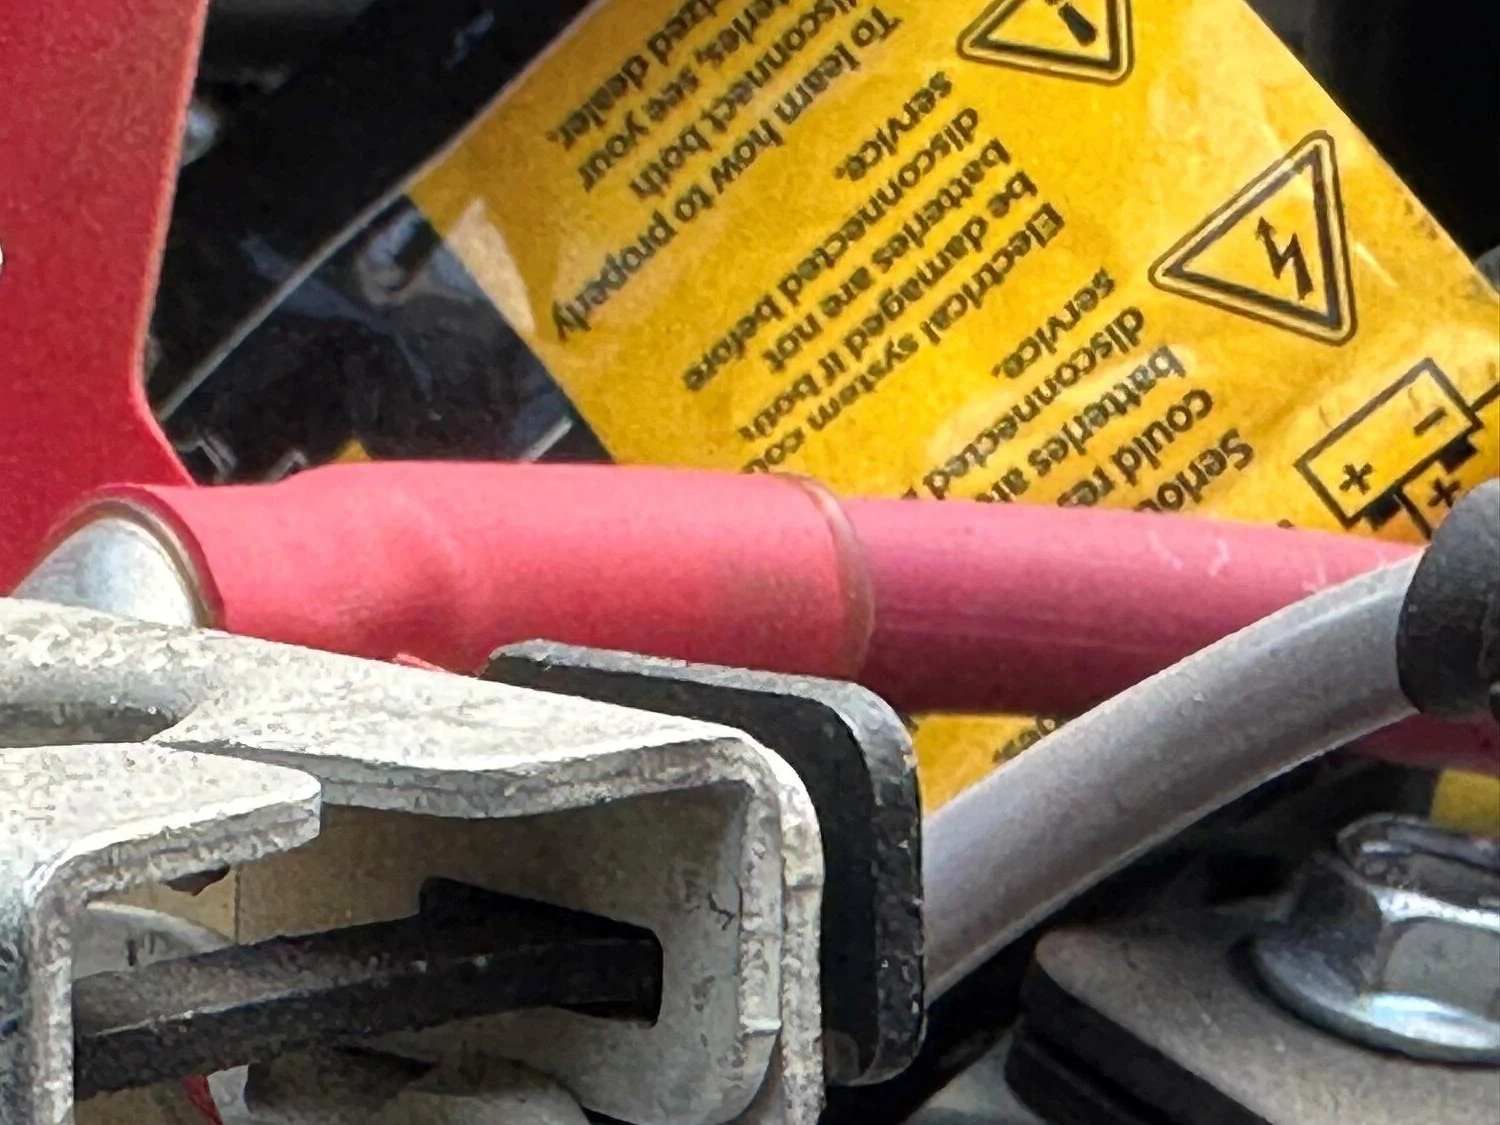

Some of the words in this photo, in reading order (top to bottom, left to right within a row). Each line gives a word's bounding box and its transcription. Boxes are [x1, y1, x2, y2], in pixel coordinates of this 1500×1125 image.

[850, 5, 902, 48] To
[548, 54, 649, 149] dealer.
[641, 64, 699, 122] see
[773, 41, 860, 124] learn
[835, 71, 952, 181] service.
[577, 110, 649, 192] your
[628, 123, 712, 199] both
[709, 118, 784, 194] how
[986, 170, 1037, 218] be
[673, 183, 714, 222] to
[777, 108, 978, 305] disconnected
[871, 138, 1010, 272] batteries
[551, 210, 676, 341] properly
[818, 265, 873, 318] are
[843, 216, 987, 360] damaged
[921, 202, 1064, 343] Electrical
[682, 293, 784, 391] before
[761, 312, 822, 372] not
[993, 268, 1114, 378] service.
[737, 373, 821, 441] both
[807, 334, 918, 430] system
[923, 307, 1143, 500] disconnected
[1027, 345, 1184, 476] batteries
[1110, 388, 1213, 486] could
